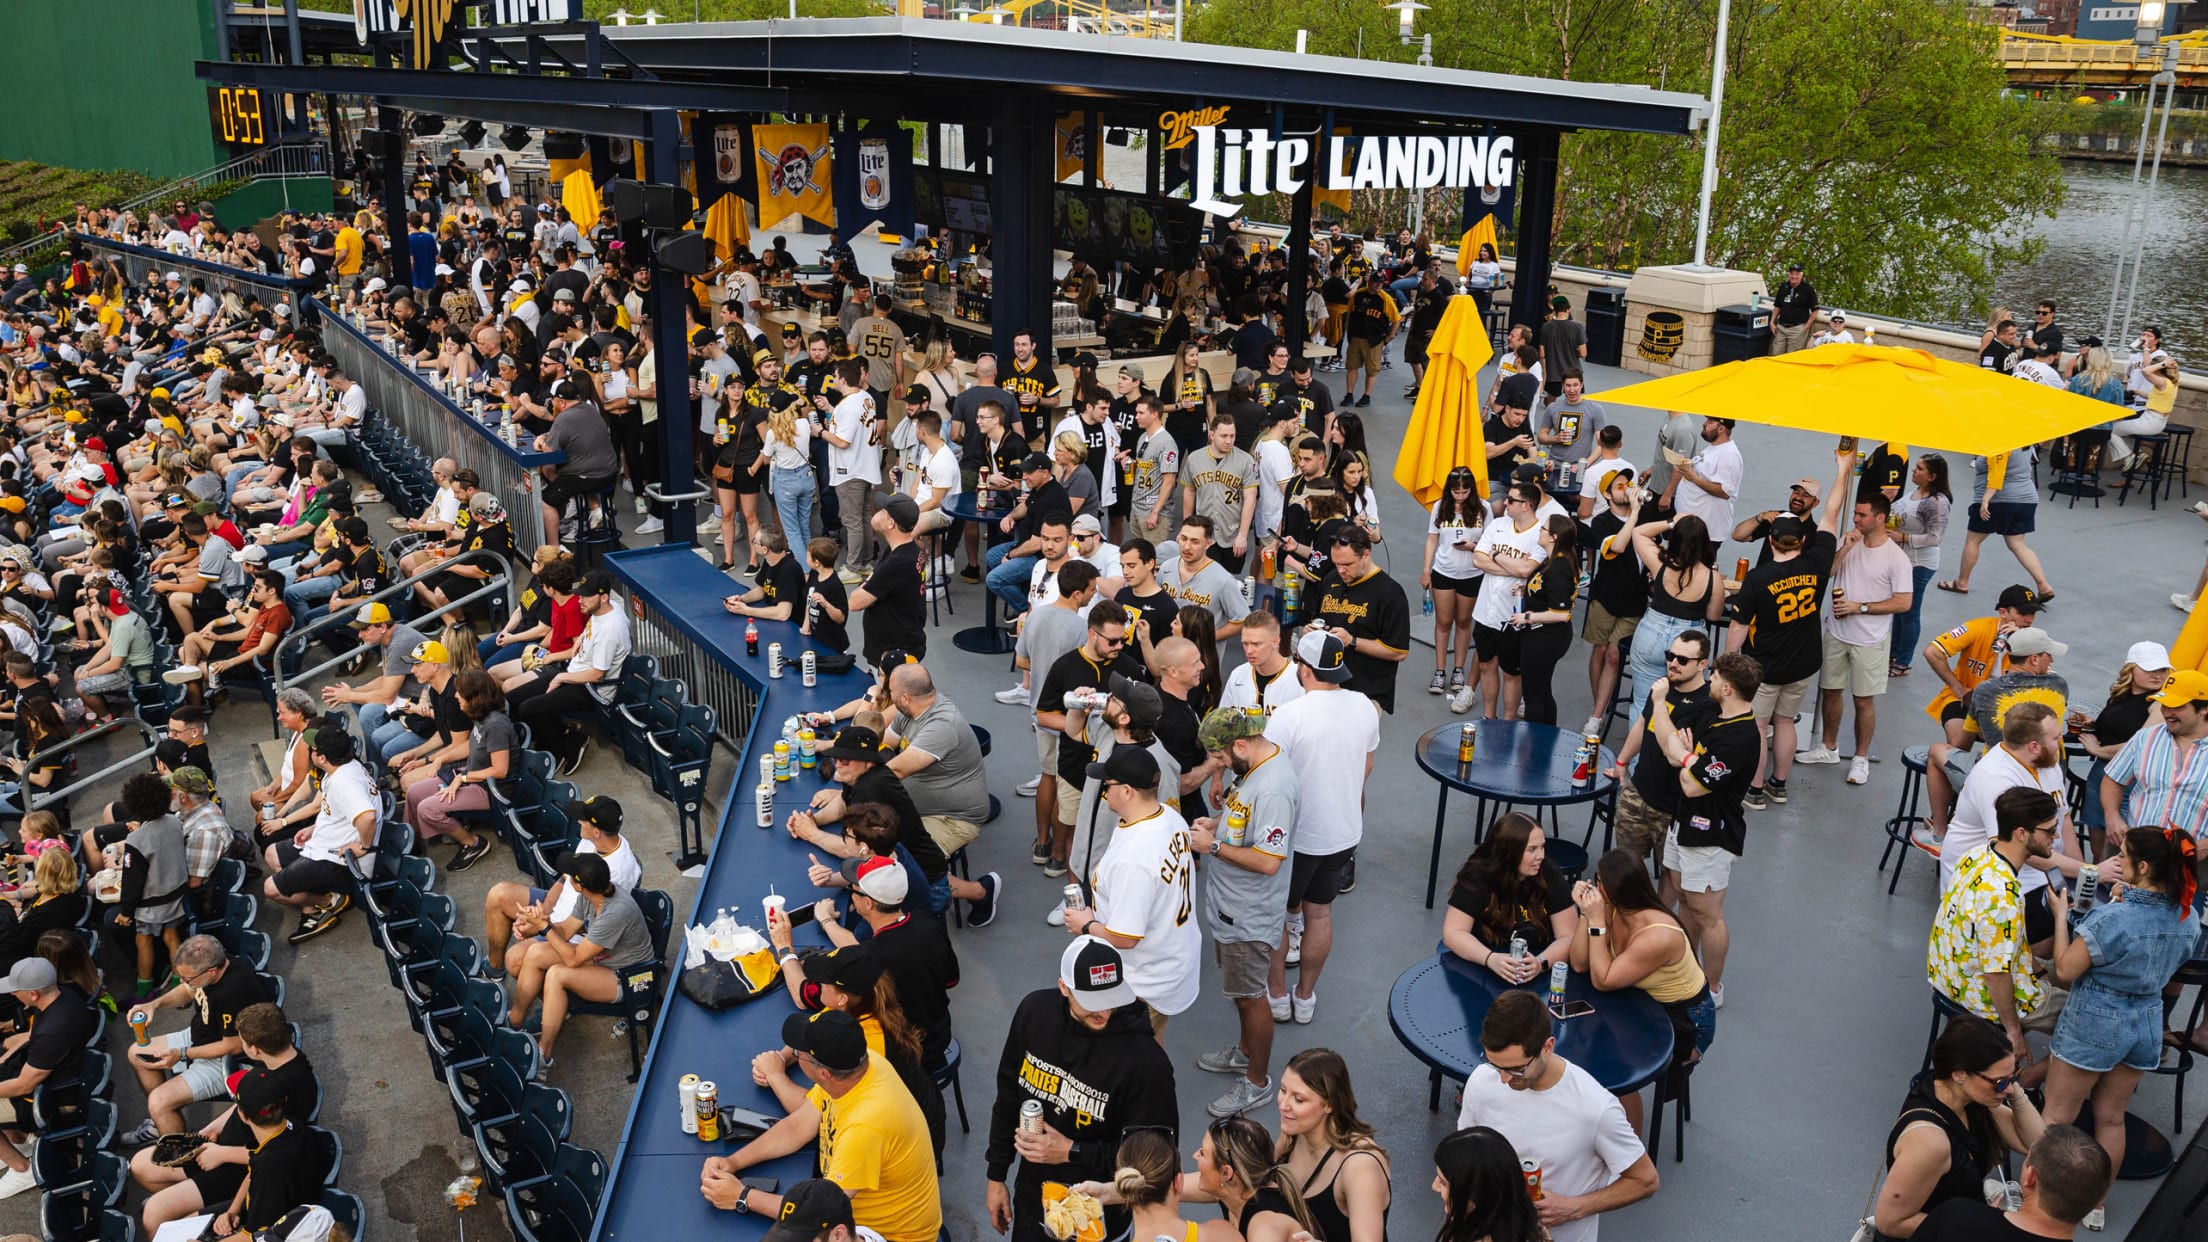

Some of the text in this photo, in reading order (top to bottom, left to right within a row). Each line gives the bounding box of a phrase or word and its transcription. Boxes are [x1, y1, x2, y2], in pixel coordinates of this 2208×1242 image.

[219, 88, 263, 143] 0:53
[1158, 105, 1231, 150] Miller
[716, 136, 737, 153] Lite
[861, 154, 885, 173] Lite
[1189, 125, 1514, 218] Lite LANDING
[872, 324, 889, 334] BELL
[1653, 329, 1663, 345] P
[865, 335, 893, 359] 55
[1138, 476, 1153, 490] 24
[1889, 470, 1899, 483] P
[1224, 490, 1240, 505] 24
[1767, 575, 1817, 596] MCCUTCHEN
[1776, 587, 1817, 624] 22
[2025, 591, 2033, 601] P
[1320, 594, 1368, 624] Pittsburgh
[1334, 651, 1344, 666] P
[2164, 676, 2176, 689] P
[1175, 859, 1192, 928] 21
[2080, 877, 2096, 900] lite
[222, 1014, 232, 1030] P
[1085, 1086, 1109, 1103] 2013
[1076, 1108, 1092, 1130] P
[780, 1201, 796, 1222] P
